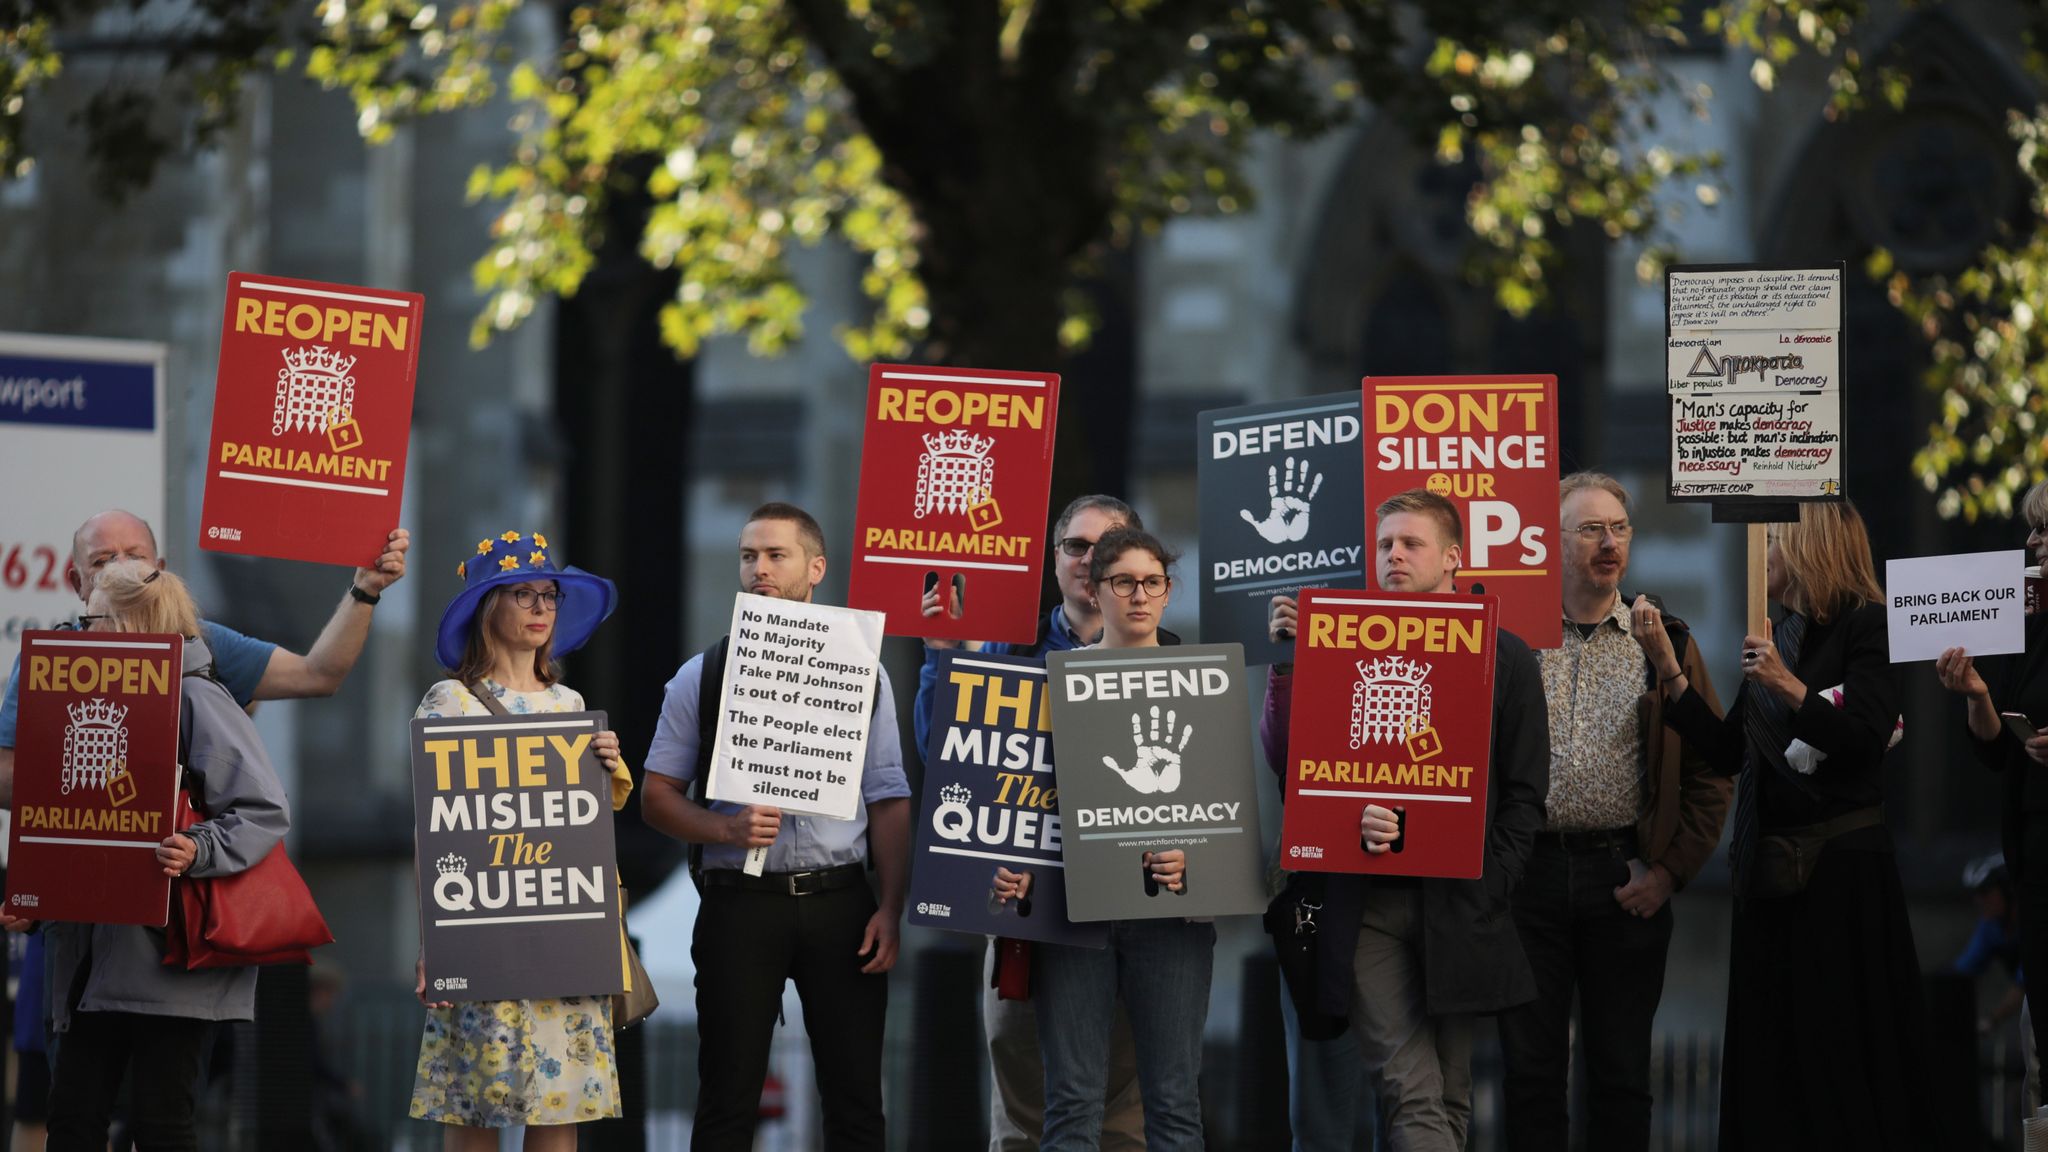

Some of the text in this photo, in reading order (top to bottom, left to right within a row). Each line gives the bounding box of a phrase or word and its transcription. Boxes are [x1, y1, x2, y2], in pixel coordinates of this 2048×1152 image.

[1672, 286, 1688, 294] that
[1738, 286, 1760, 296] group
[1764, 283, 1788, 292] should
[1808, 283, 1831, 291] claim
[1784, 291, 1830, 300] educational
[1718, 301, 1730, 309] the
[1783, 300, 1804, 312] right
[235, 297, 408, 351] REOPEN
[1779, 334, 1791, 343] La
[1670, 378, 1723, 392] Liber populus
[1775, 375, 1827, 388] Democracy
[877, 387, 1044, 429] REOPEN
[1375, 392, 1544, 434] DON'T
[1729, 402, 1783, 422] capacity
[1787, 400, 1809, 420] for
[1213, 415, 1360, 460] DEFEND
[1719, 419, 1751, 431] makes
[1753, 417, 1812, 435] democracy
[1727, 432, 1748, 444] but
[1754, 432, 1786, 444] man's
[1789, 430, 1838, 444] inclination
[221, 441, 391, 481] PARLIAMENT
[1377, 435, 1546, 472] SILENCE
[1678, 446, 1832, 464] to injustice makes democracy
[1753, 461, 1783, 470] Reinhold
[1787, 461, 1818, 471] Niebuhr
[865, 527, 1031, 558] PARLIAMENT
[1458, 501, 1547, 568] Ps
[1214, 546, 1362, 581] DEMOCRACY
[1894, 587, 2016, 608] BRING BACK OUR
[742, 610, 829, 633] No Mandate
[1910, 608, 1999, 626] PARLIAMENT
[739, 628, 825, 653] No Majority
[1308, 613, 1483, 654] REOPEN
[29, 655, 170, 695] REOPEN
[736, 646, 870, 676] No Moral Compass
[739, 664, 863, 693] Fake PM Johnson
[1065, 668, 1230, 702] DEFEND
[733, 684, 863, 714] is out of control
[729, 710, 862, 741] The People elect
[424, 733, 594, 791] THEY
[731, 733, 853, 762] the Parliament
[940, 725, 1053, 773] MISL
[731, 757, 847, 785] It must not be
[1299, 759, 1473, 788] PARLIAMENT
[752, 781, 820, 801] silenced
[994, 772, 1057, 809] The
[20, 805, 162, 833] PARLIAMENT
[429, 789, 599, 832] MISLED
[1077, 802, 1241, 828] DEMOCRACY
[932, 802, 1061, 851] QUEE
[488, 832, 552, 867] The
[1118, 836, 1208, 848] www.marchforchange.uk
[433, 865, 605, 912] QUEEN
